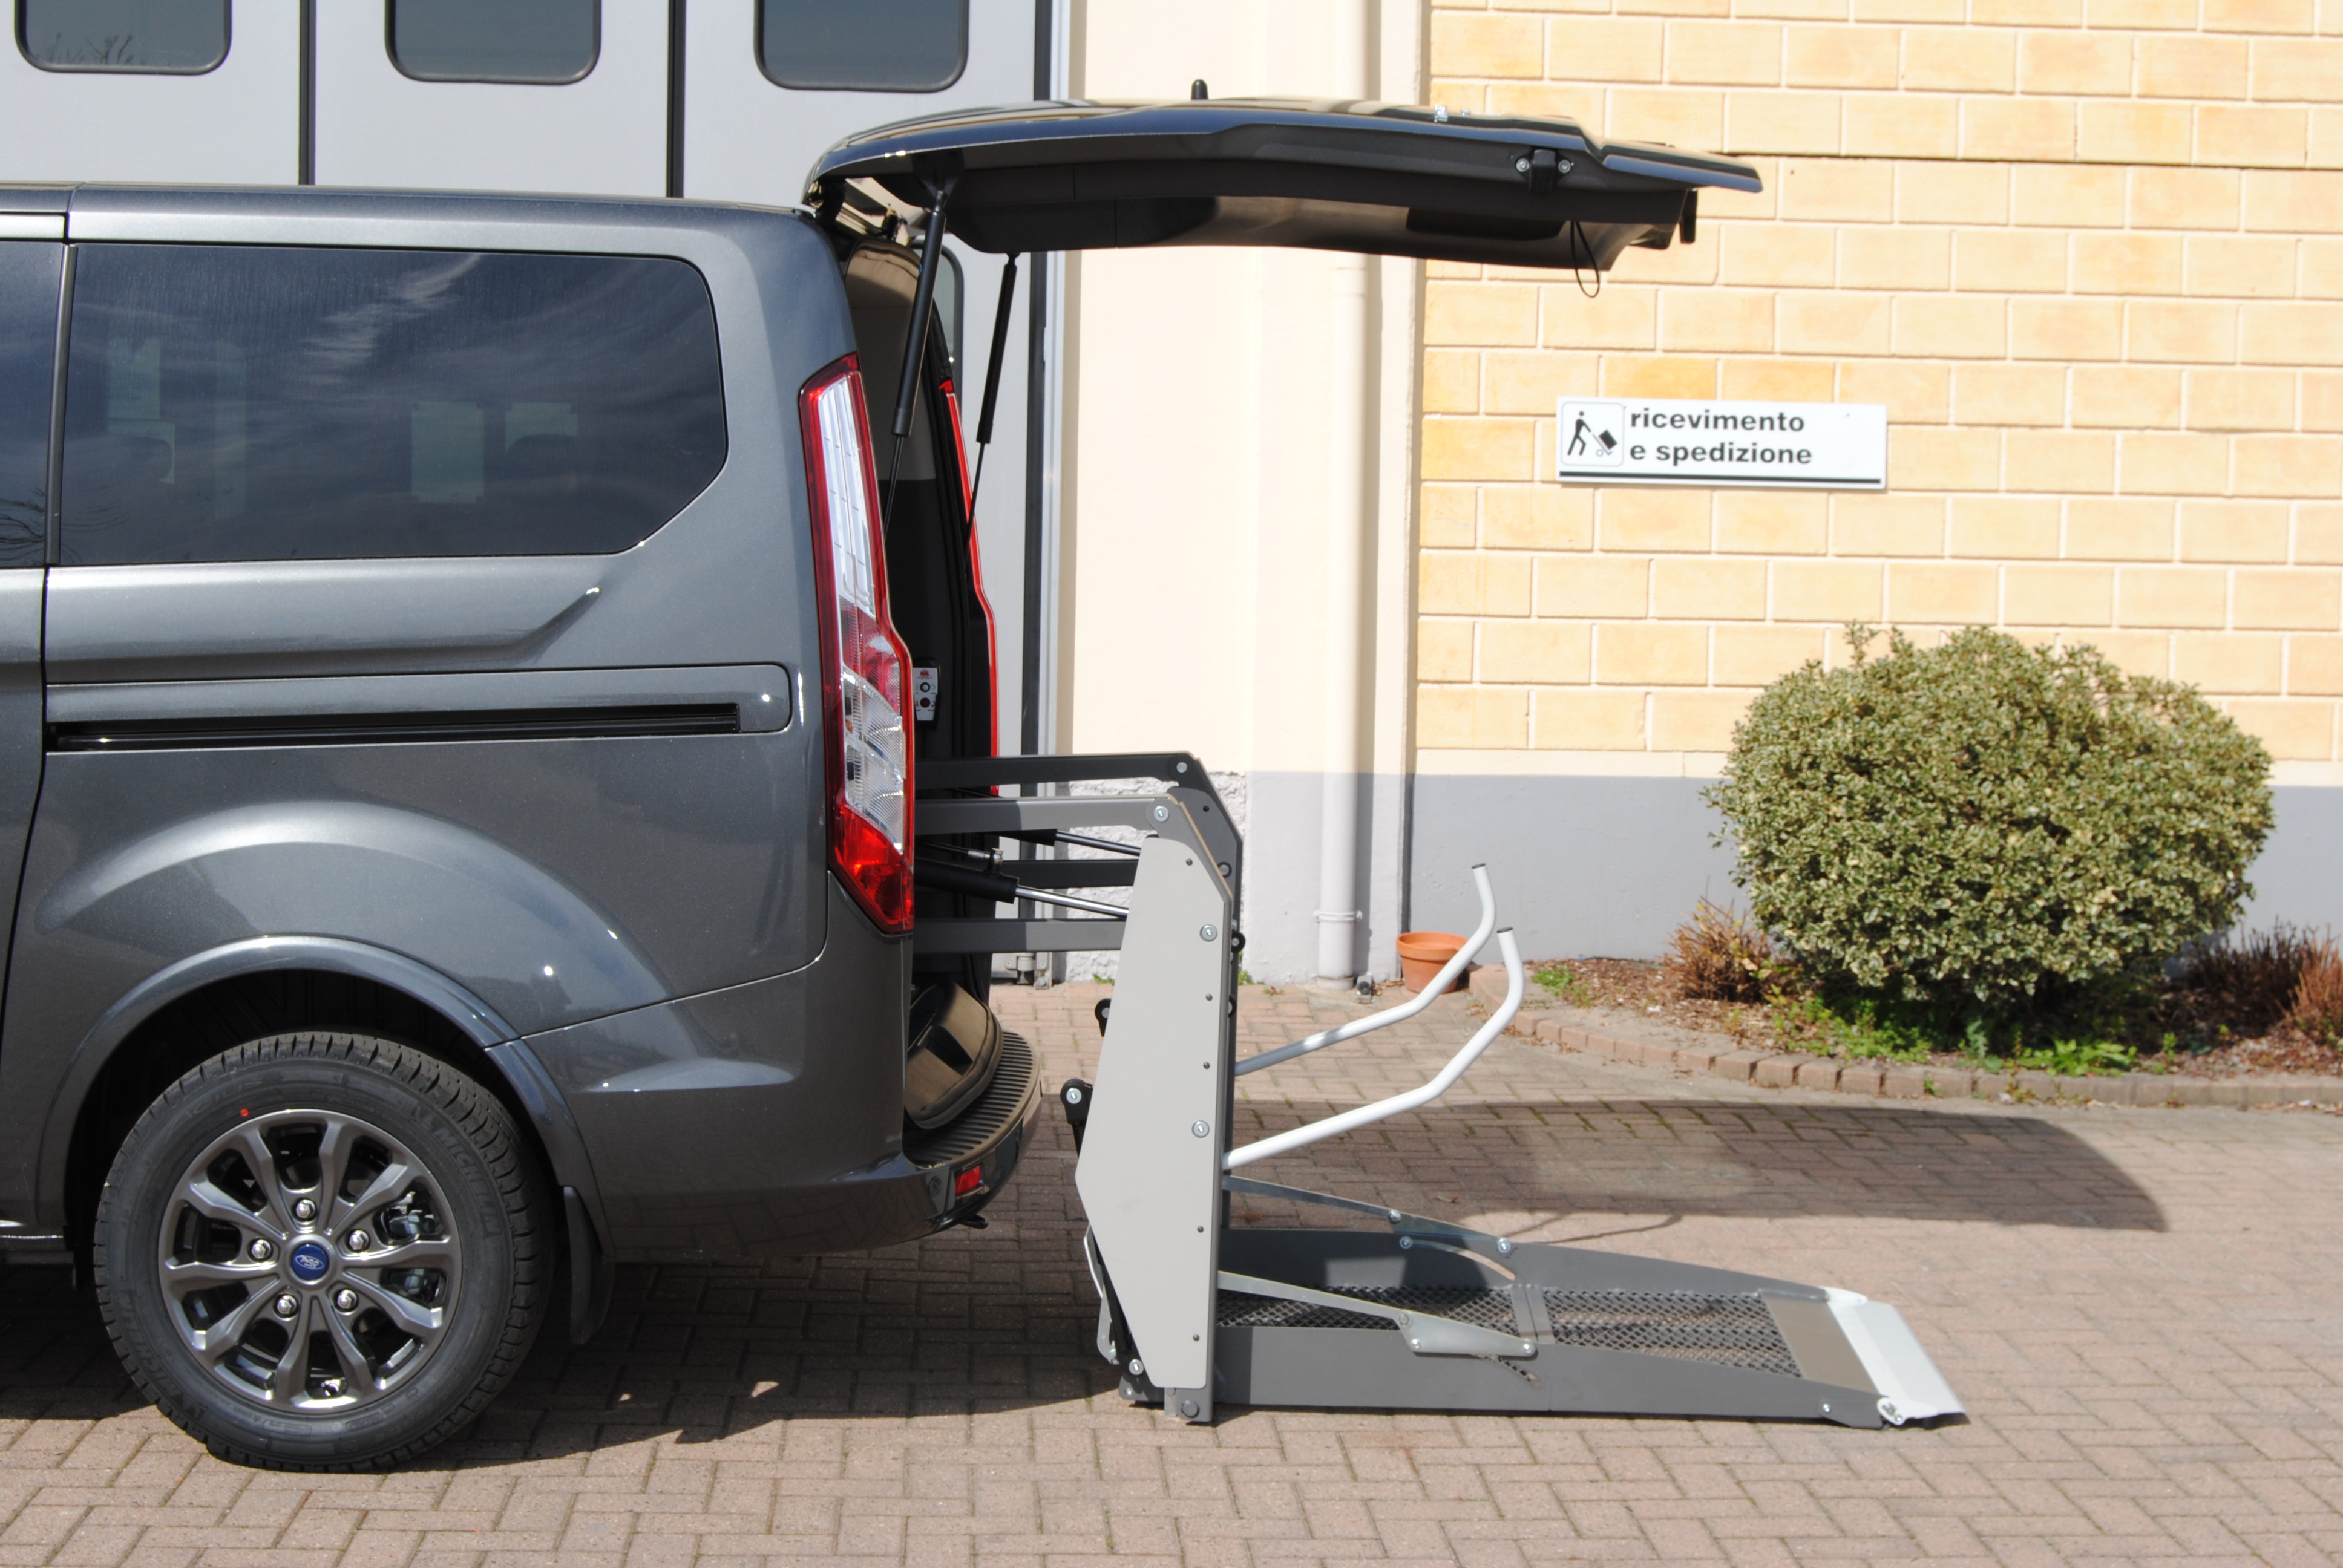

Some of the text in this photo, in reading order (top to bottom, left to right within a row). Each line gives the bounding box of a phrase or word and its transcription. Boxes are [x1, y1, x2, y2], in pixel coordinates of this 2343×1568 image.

[1631, 408, 1804, 432] ricevimento
[1630, 442, 1812, 466] e spedizione
[433, 1125, 500, 1234] MICHELIN
[117, 1292, 183, 1398] MICHELIN
